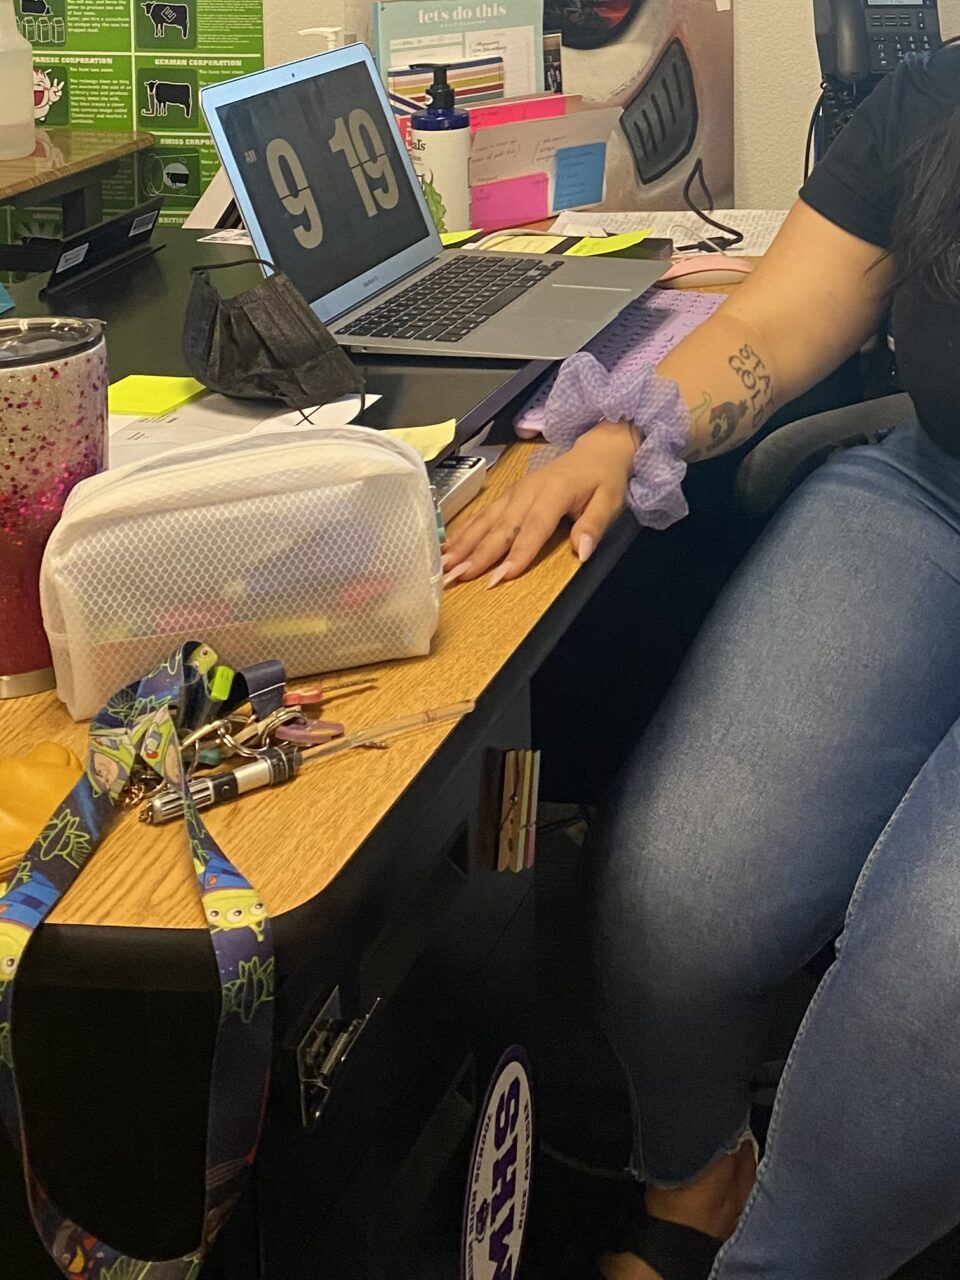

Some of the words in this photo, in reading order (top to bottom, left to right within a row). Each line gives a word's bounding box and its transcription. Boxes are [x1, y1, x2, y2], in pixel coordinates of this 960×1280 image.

[452, 6, 472, 19] do
[476, 3, 507, 18] this
[266, 138, 323, 249] 9
[329, 108, 399, 218] 19
[474, 1112, 493, 1184] SCHOOL
